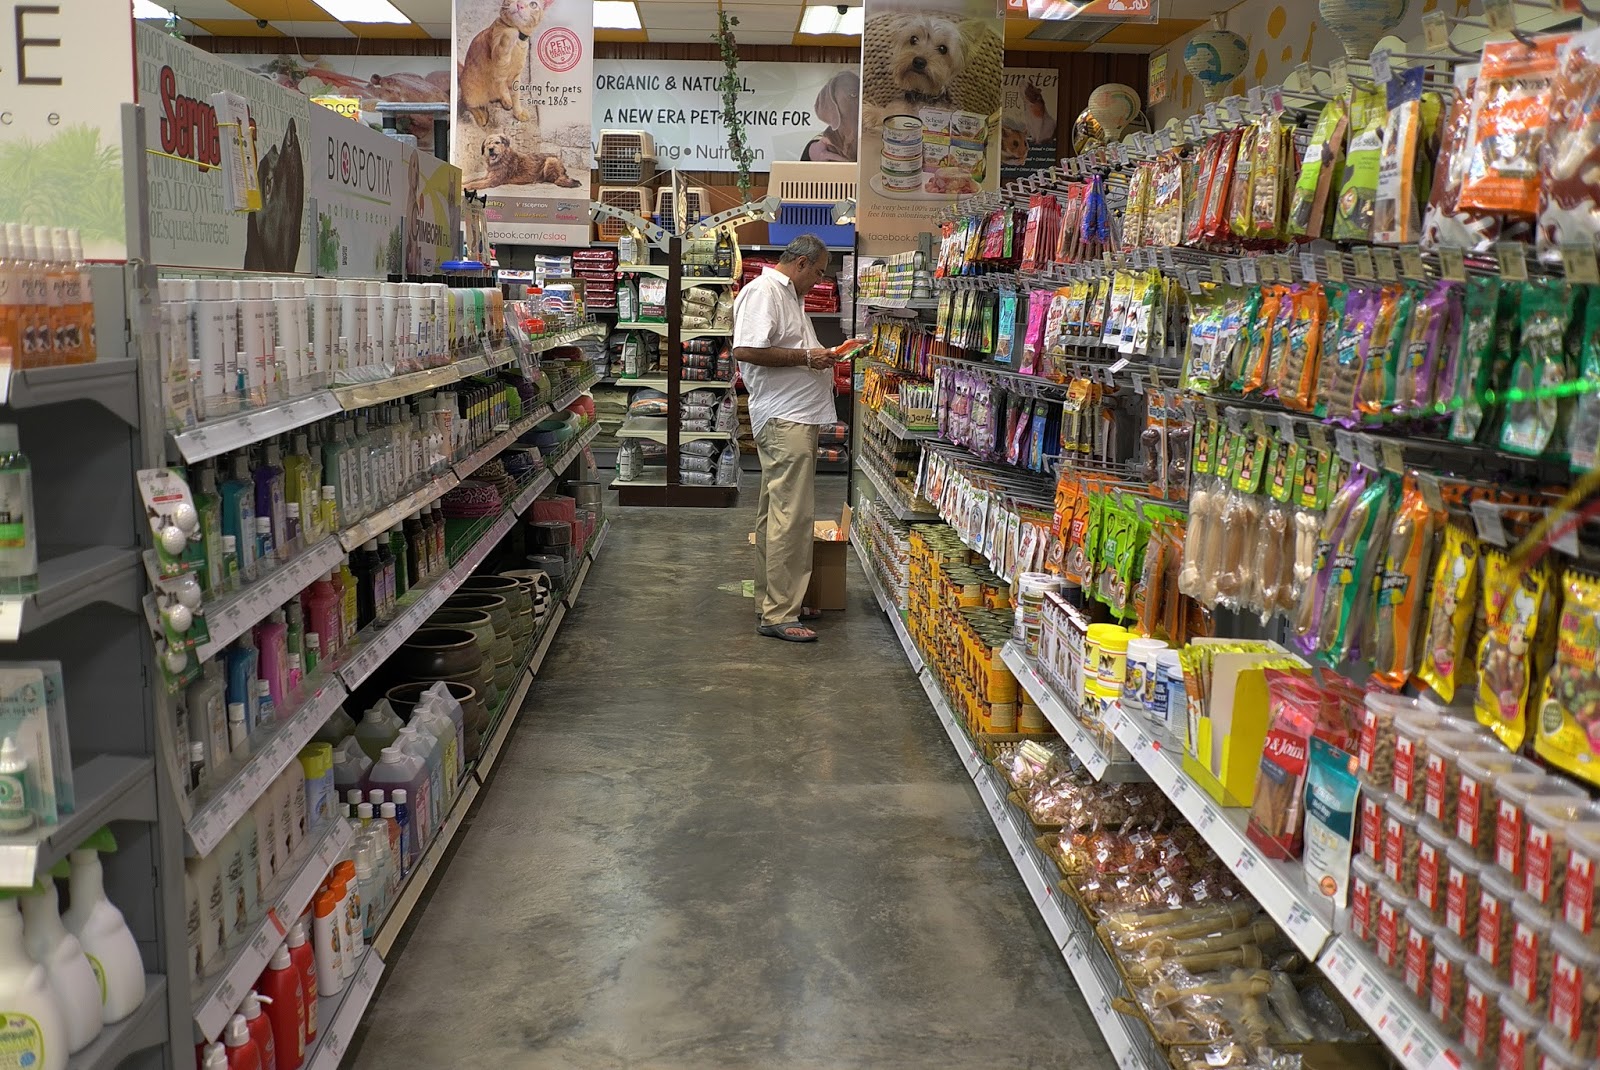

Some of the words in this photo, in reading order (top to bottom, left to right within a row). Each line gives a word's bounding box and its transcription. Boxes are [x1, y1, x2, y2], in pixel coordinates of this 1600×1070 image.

[550, 39, 567, 49] PET
[512, 80, 542, 95] Caring
[545, 81, 560, 93] for
[562, 86, 582, 98] pets
[596, 75, 660, 91] ORGANIC
[665, 76, 677, 90] &
[683, 76, 755, 94] NATUAL,
[548, 96, 568, 106] 1868
[603, 108, 613, 123] A
[618, 108, 653, 123] NEW
[657, 109, 685, 124] ERA
[691, 110, 719, 125] PET
[782, 111, 811, 126] FOR
[327, 136, 392, 197] BIOSPOTIX
